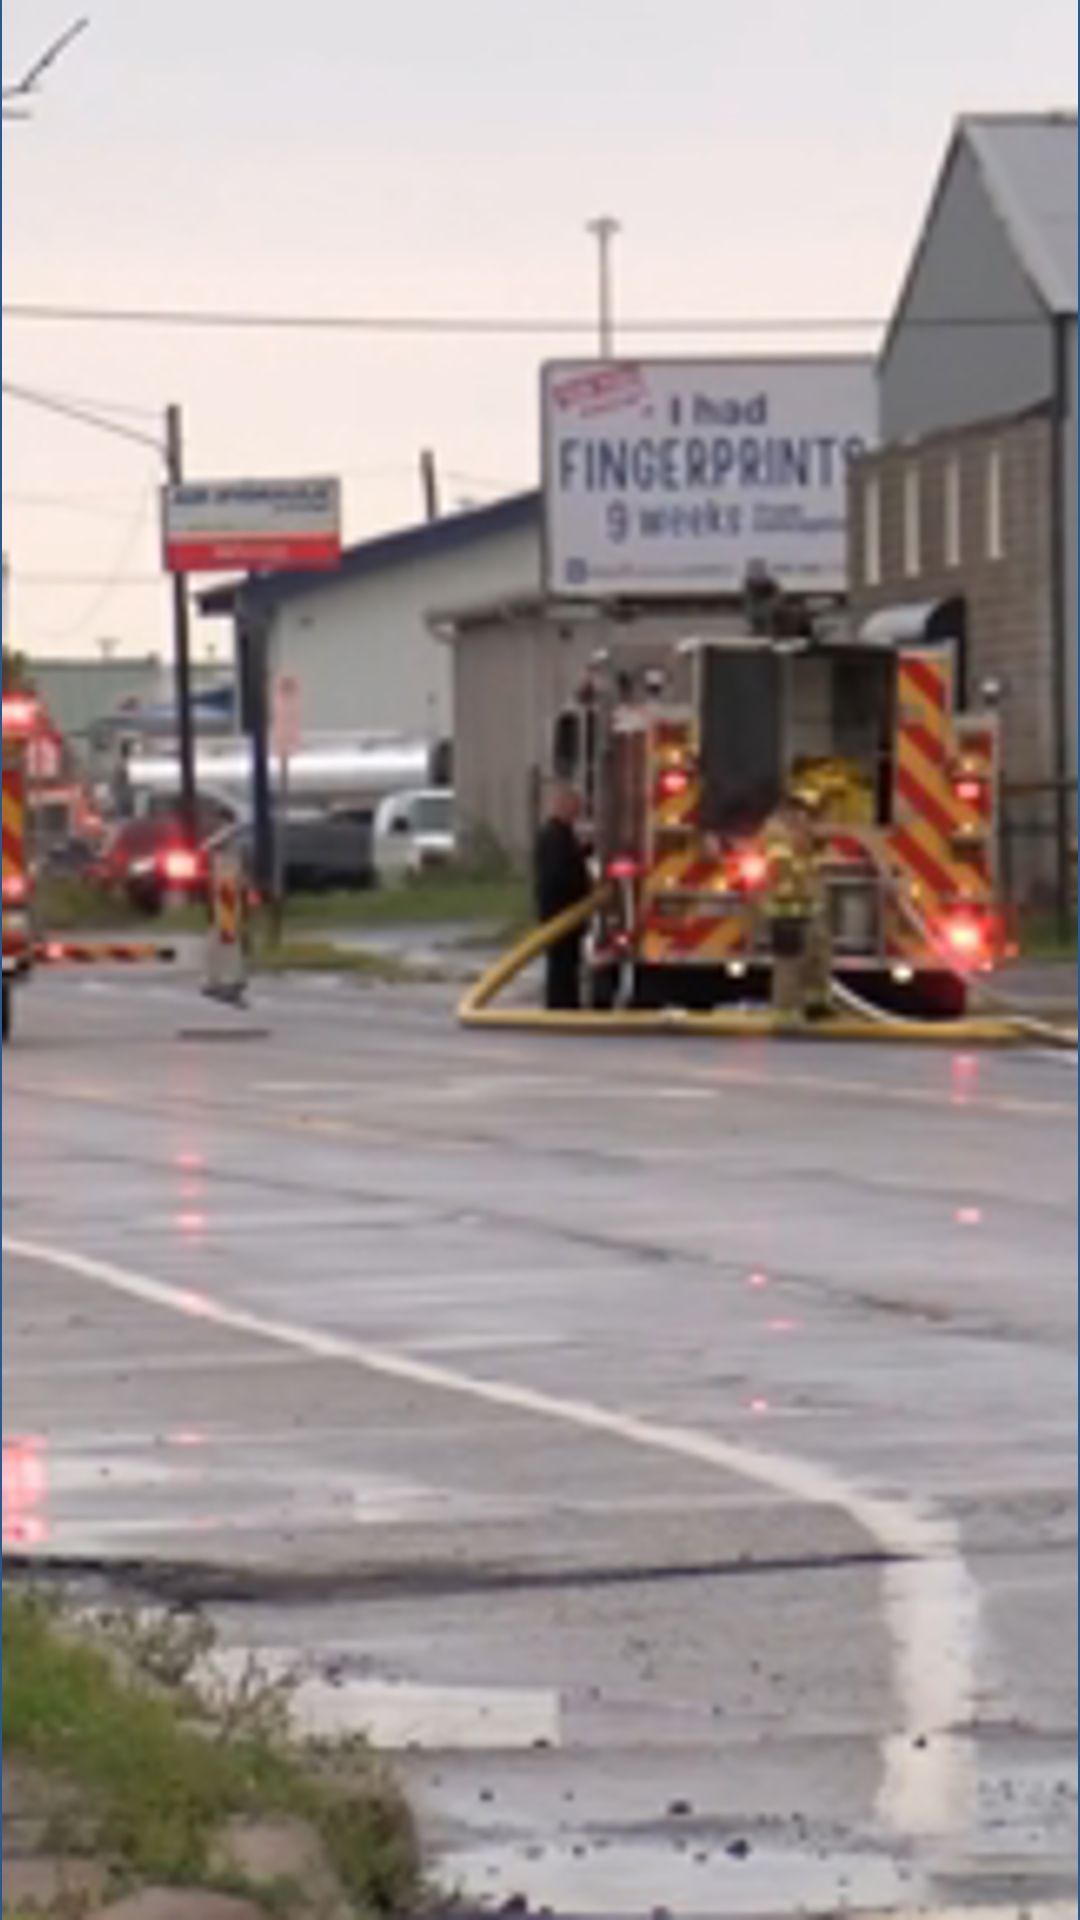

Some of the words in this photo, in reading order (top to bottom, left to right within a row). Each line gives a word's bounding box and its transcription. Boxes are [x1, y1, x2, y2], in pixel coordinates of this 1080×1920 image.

[670, 395, 681, 426] I
[692, 392, 767, 426] had
[606, 500, 629, 542] 9
[639, 500, 741, 537] weeks
